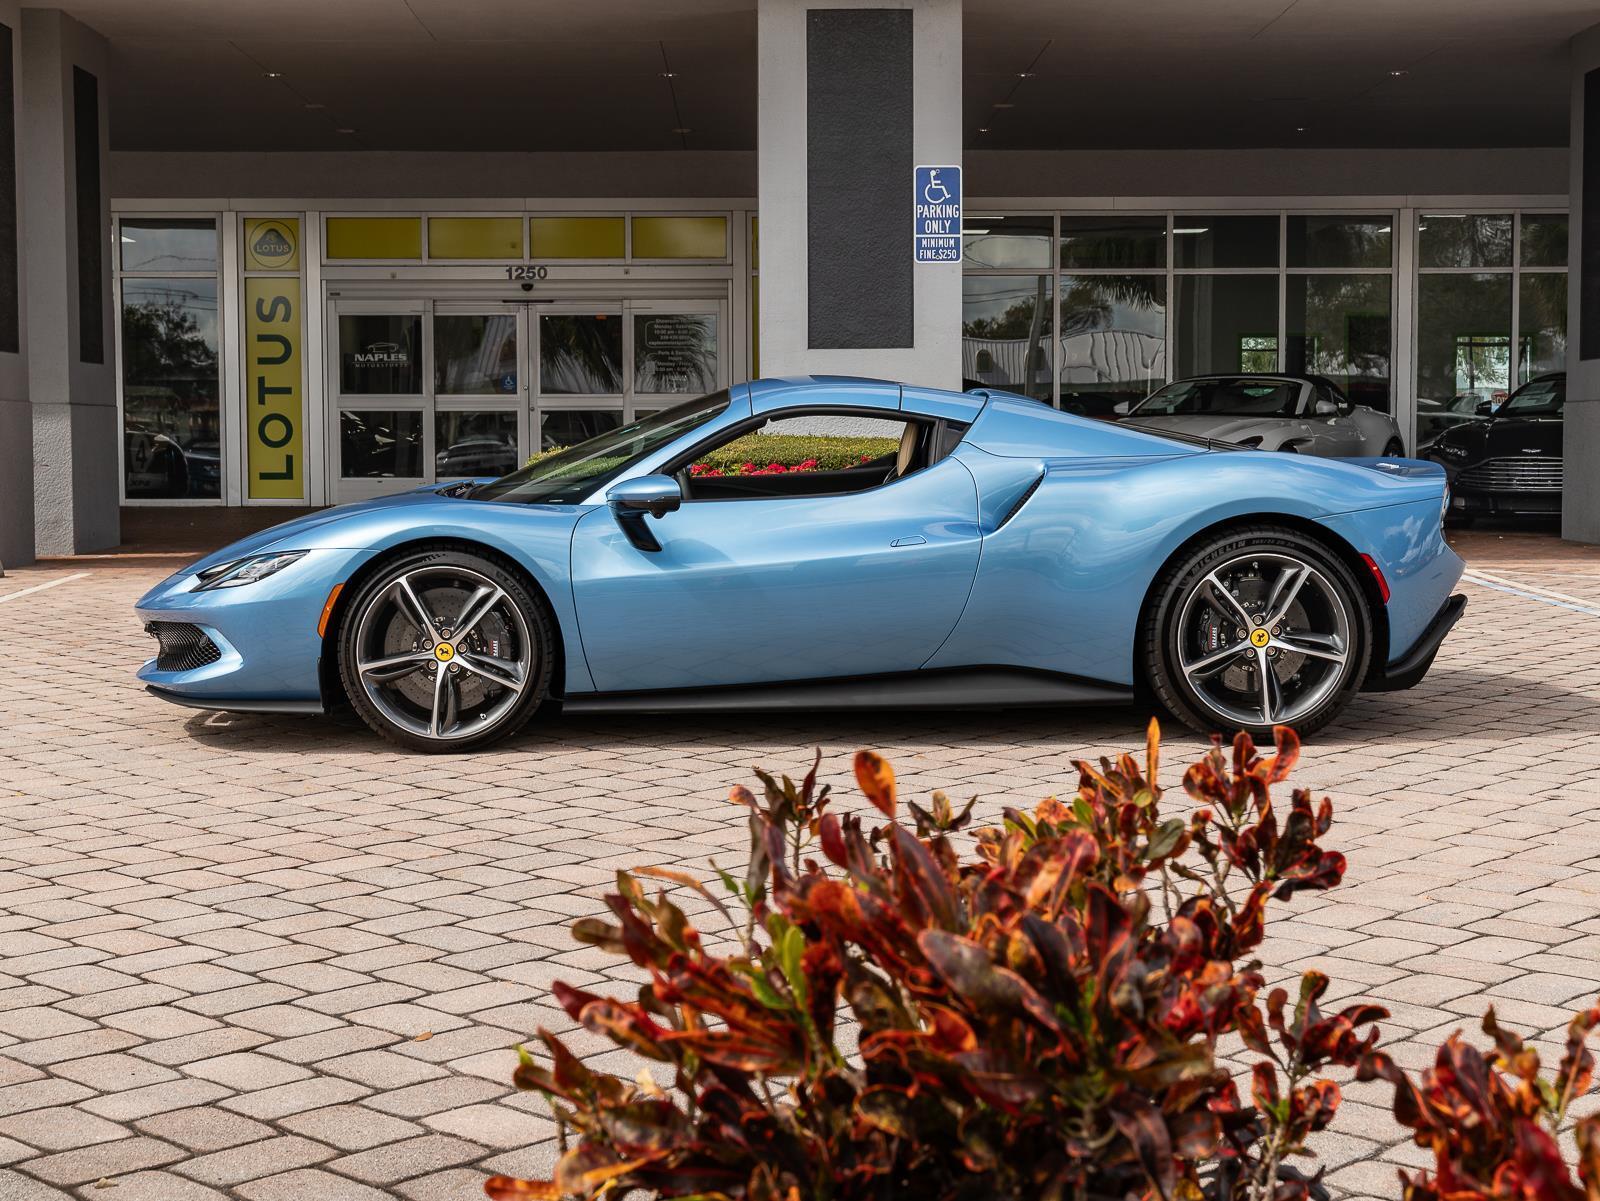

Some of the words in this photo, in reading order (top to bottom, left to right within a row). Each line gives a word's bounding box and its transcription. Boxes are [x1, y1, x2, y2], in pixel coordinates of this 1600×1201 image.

[917, 204, 959, 218] PARKING
[925, 219, 951, 233] ONLY
[256, 244, 289, 252] LOTUS
[921, 238, 955, 248] MINIMUM
[919, 249, 937, 259] FINE
[938, 248, 957, 259] $250
[505, 264, 548, 280] 1250
[354, 353, 407, 361] NAPLES
[255, 295, 293, 481] LOTUS
[1191, 540, 1246, 574] MICHELIN
